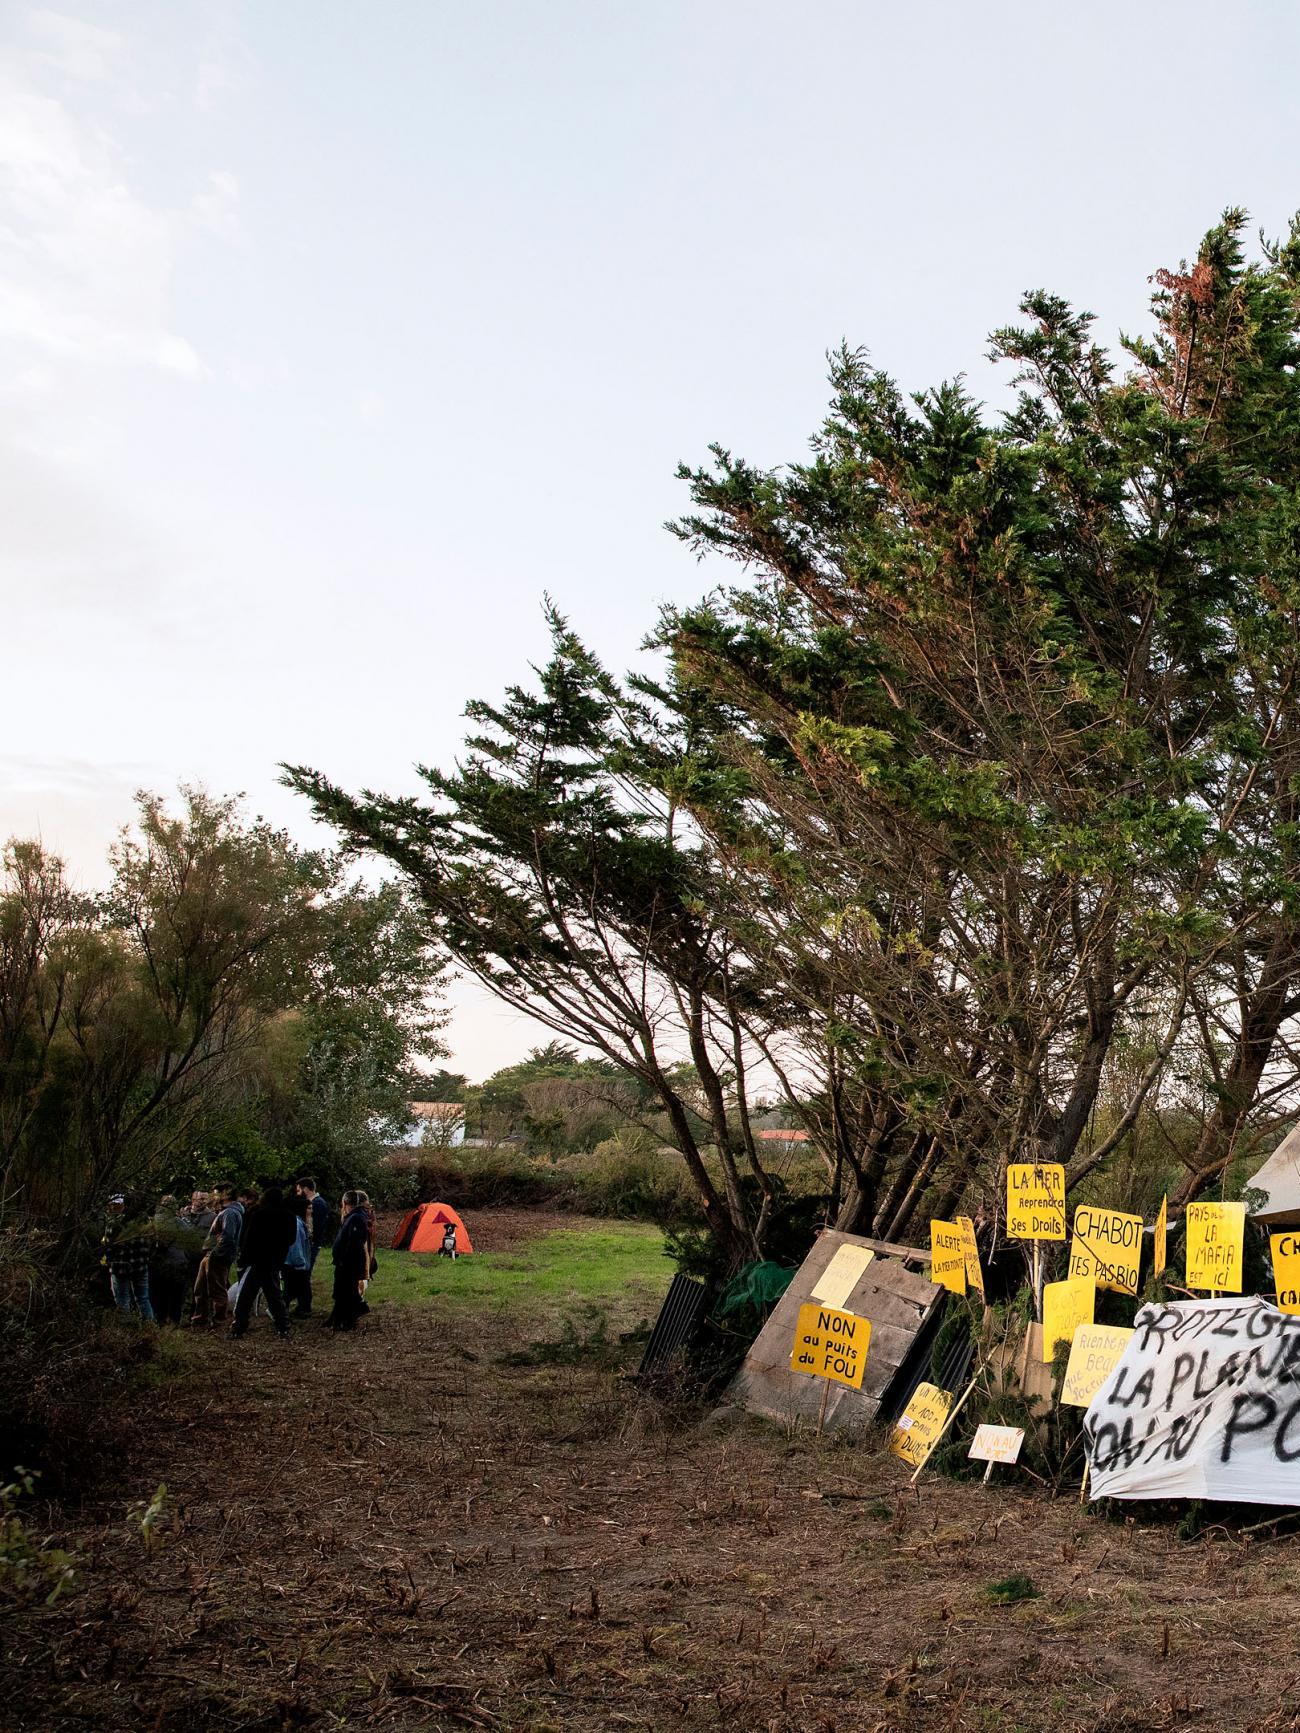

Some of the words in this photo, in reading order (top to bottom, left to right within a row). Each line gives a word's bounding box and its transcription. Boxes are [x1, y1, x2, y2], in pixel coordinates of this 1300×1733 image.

[1012, 1171, 1029, 1190] LA
[1011, 1217, 1027, 1232] Ses
[1188, 1204, 1210, 1225] PAYS
[1075, 1211, 1144, 1249] CHABOT
[1204, 1224, 1218, 1243] LA
[935, 1233, 961, 1252] ALERTE
[1195, 1244, 1236, 1265] MAFIA
[1070, 1255, 1091, 1277] TES
[817, 1311, 857, 1339] NON
[803, 1335, 819, 1347] au
[825, 1338, 858, 1360] puits
[798, 1352, 815, 1365] du
[823, 1354, 857, 1379] FOU
[1107, 1366, 1153, 1410] LA
